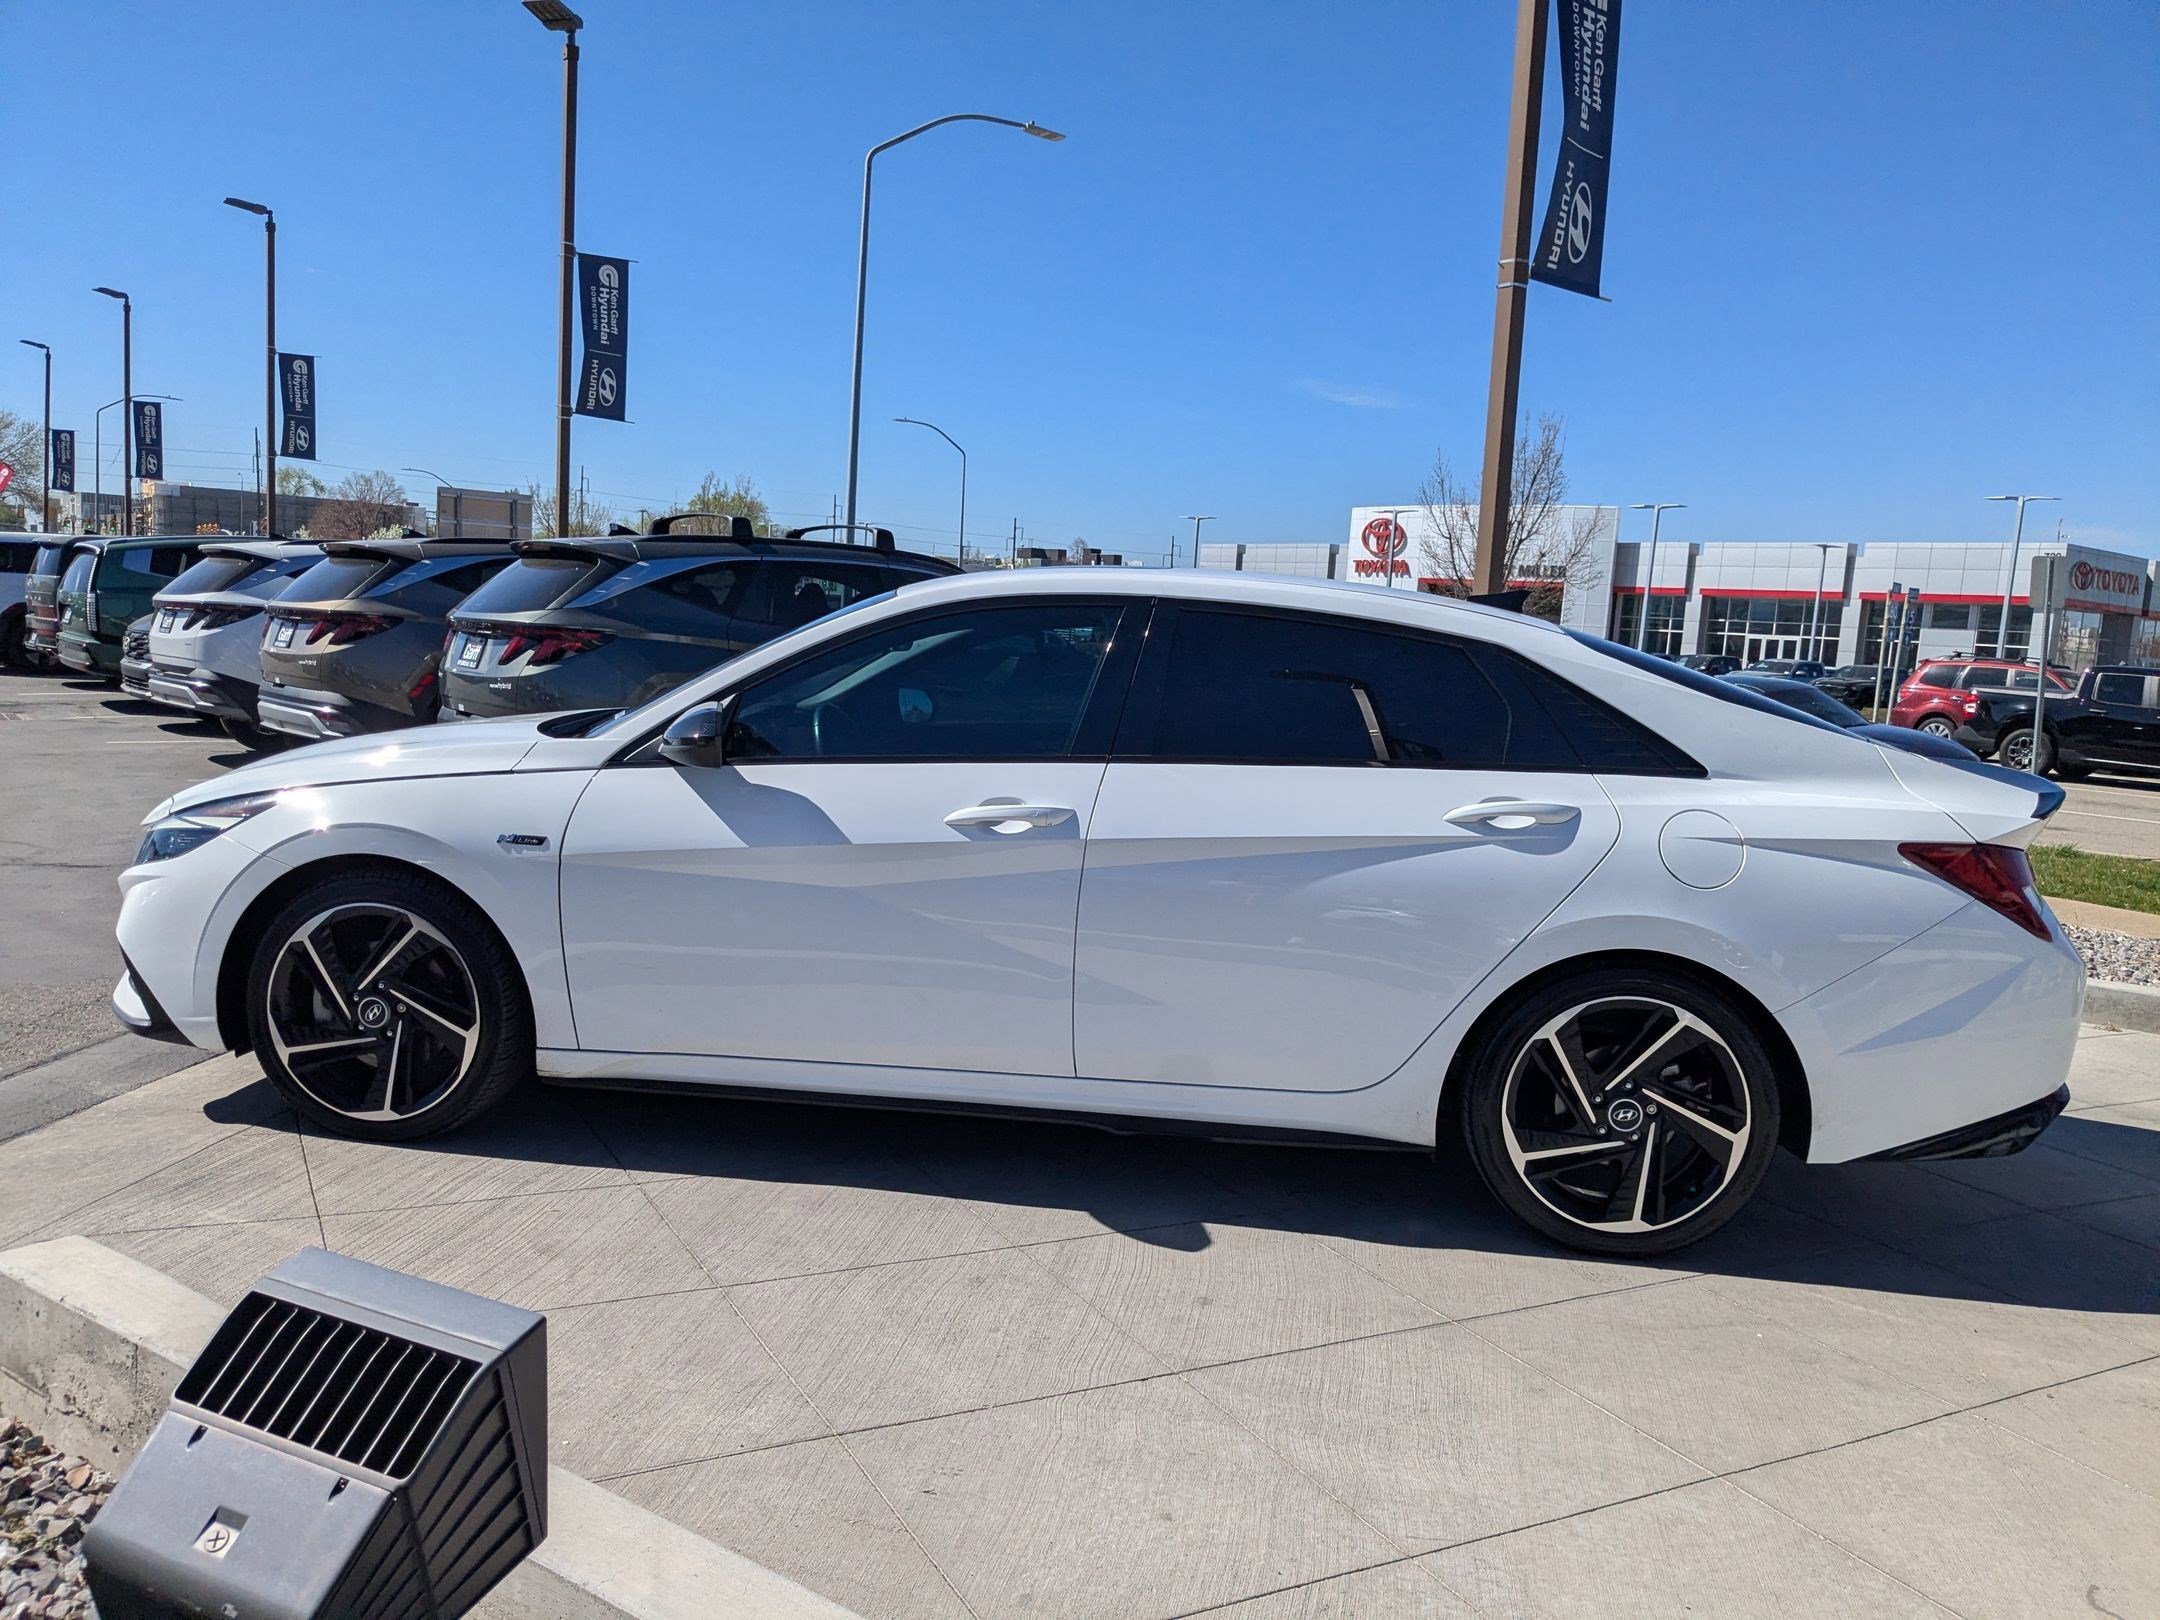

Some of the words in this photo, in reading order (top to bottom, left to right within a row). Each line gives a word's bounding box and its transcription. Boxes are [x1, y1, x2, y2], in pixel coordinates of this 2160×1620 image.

[1572, 2, 1580, 97] DOWNTOWN
[1595, 13, 1607, 55] Ken
[1580, 7, 1596, 132] Hyundai
[1592, 59, 1605, 112] Garff
[1547, 160, 1575, 270] HYUNDAI
[590, 285, 598, 331] DOWNTOWN
[598, 287, 610, 345] Hyundai
[610, 289, 619, 309] Ken
[610, 310, 619, 335] Garff
[293, 374, 303, 412] Hyundai
[586, 359, 599, 410] HYUNDAI
[287, 420, 296, 454] HYUNDAI
[2093, 567, 2139, 595] TOYOTA
[463, 643, 482, 660] Garff
